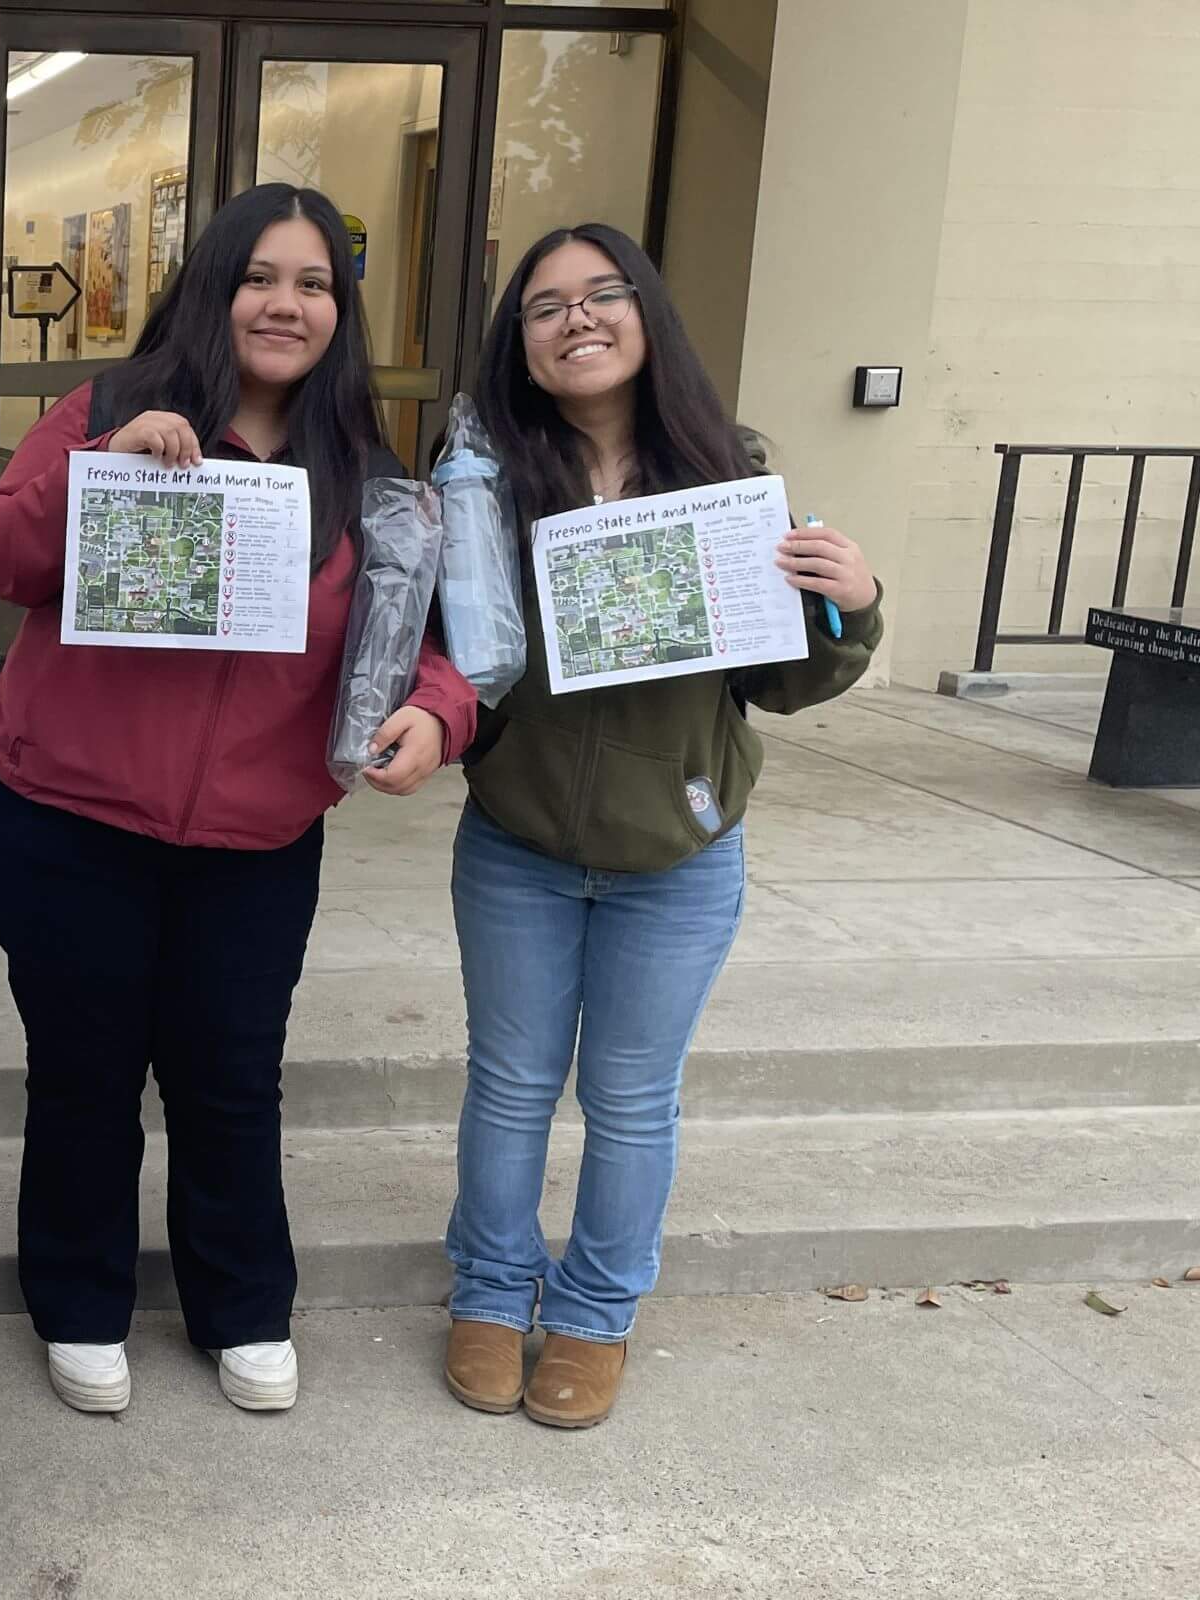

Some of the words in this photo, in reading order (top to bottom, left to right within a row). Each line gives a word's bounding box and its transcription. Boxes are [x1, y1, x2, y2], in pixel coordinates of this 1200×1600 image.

[87, 467, 130, 482] Fresno
[135, 469, 167, 484] State
[172, 470, 191, 485] Art
[197, 472, 221, 486] and
[225, 474, 261, 489] Mural
[267, 477, 295, 491] Tour
[549, 523, 592, 541] Fresno
[596, 514, 632, 530] State
[636, 509, 656, 523] Art
[661, 506, 687, 519] and
[692, 496, 731, 513] Mural
[736, 490, 768, 506] Tour
[1092, 612, 1136, 633] Dedicated
[1139, 625, 1149, 636] to
[1156, 627, 1170, 640] the
[1094, 630, 1105, 642] of
[1107, 632, 1145, 653] learning
[1148, 642, 1185, 661] through
